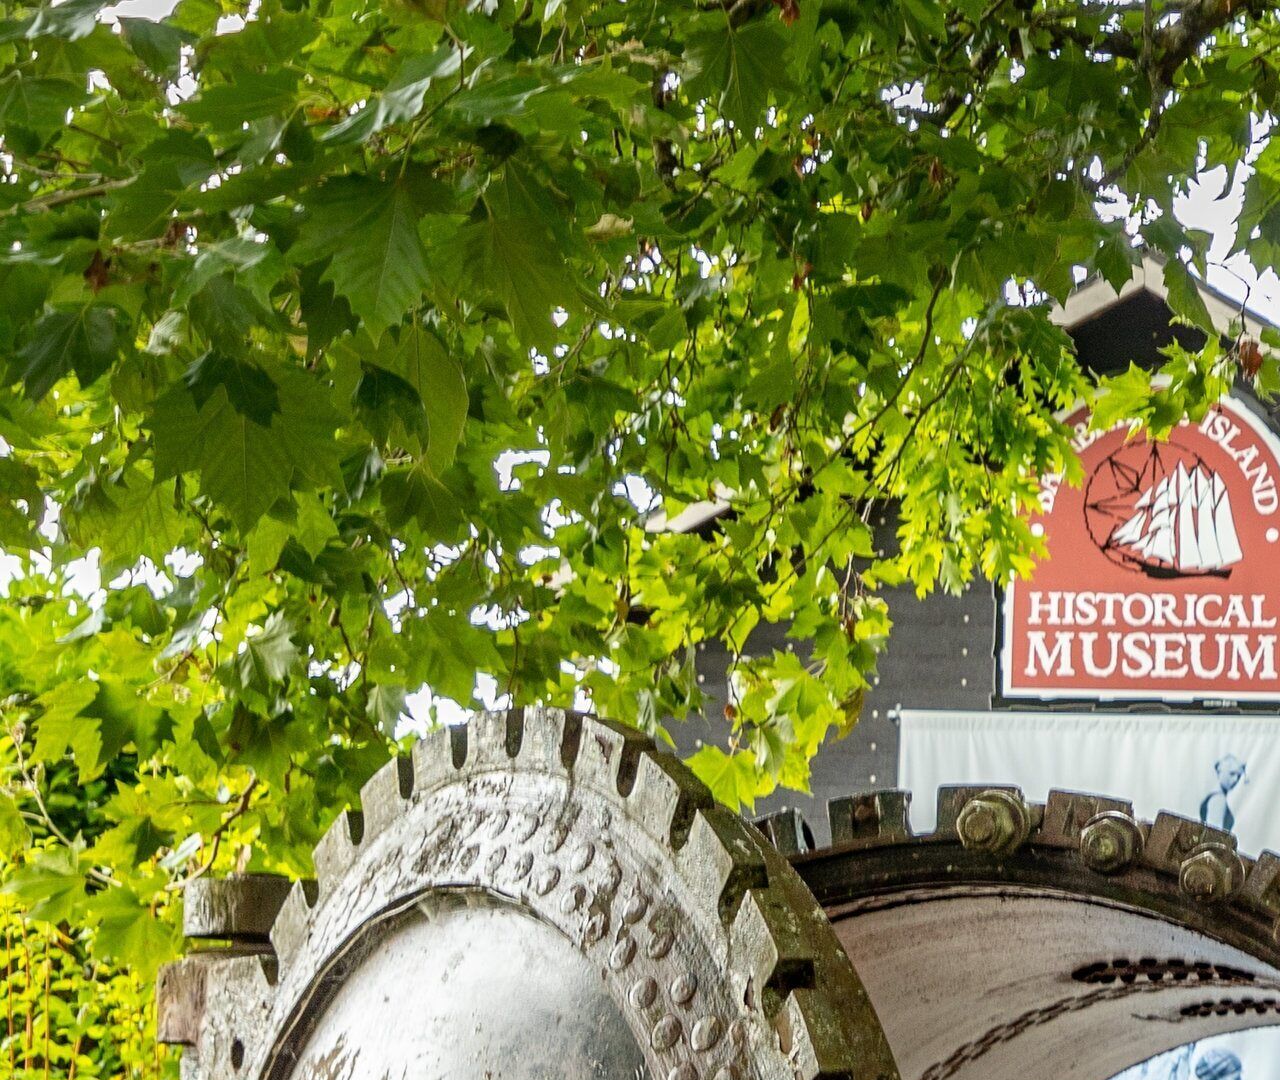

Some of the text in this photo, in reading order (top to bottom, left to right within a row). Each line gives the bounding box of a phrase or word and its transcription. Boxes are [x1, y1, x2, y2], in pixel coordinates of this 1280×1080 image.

[1199, 410, 1279, 515] ISLAND
[1028, 591, 1277, 627] HISTORICAL
[1025, 631, 1278, 679] MUSEUM
